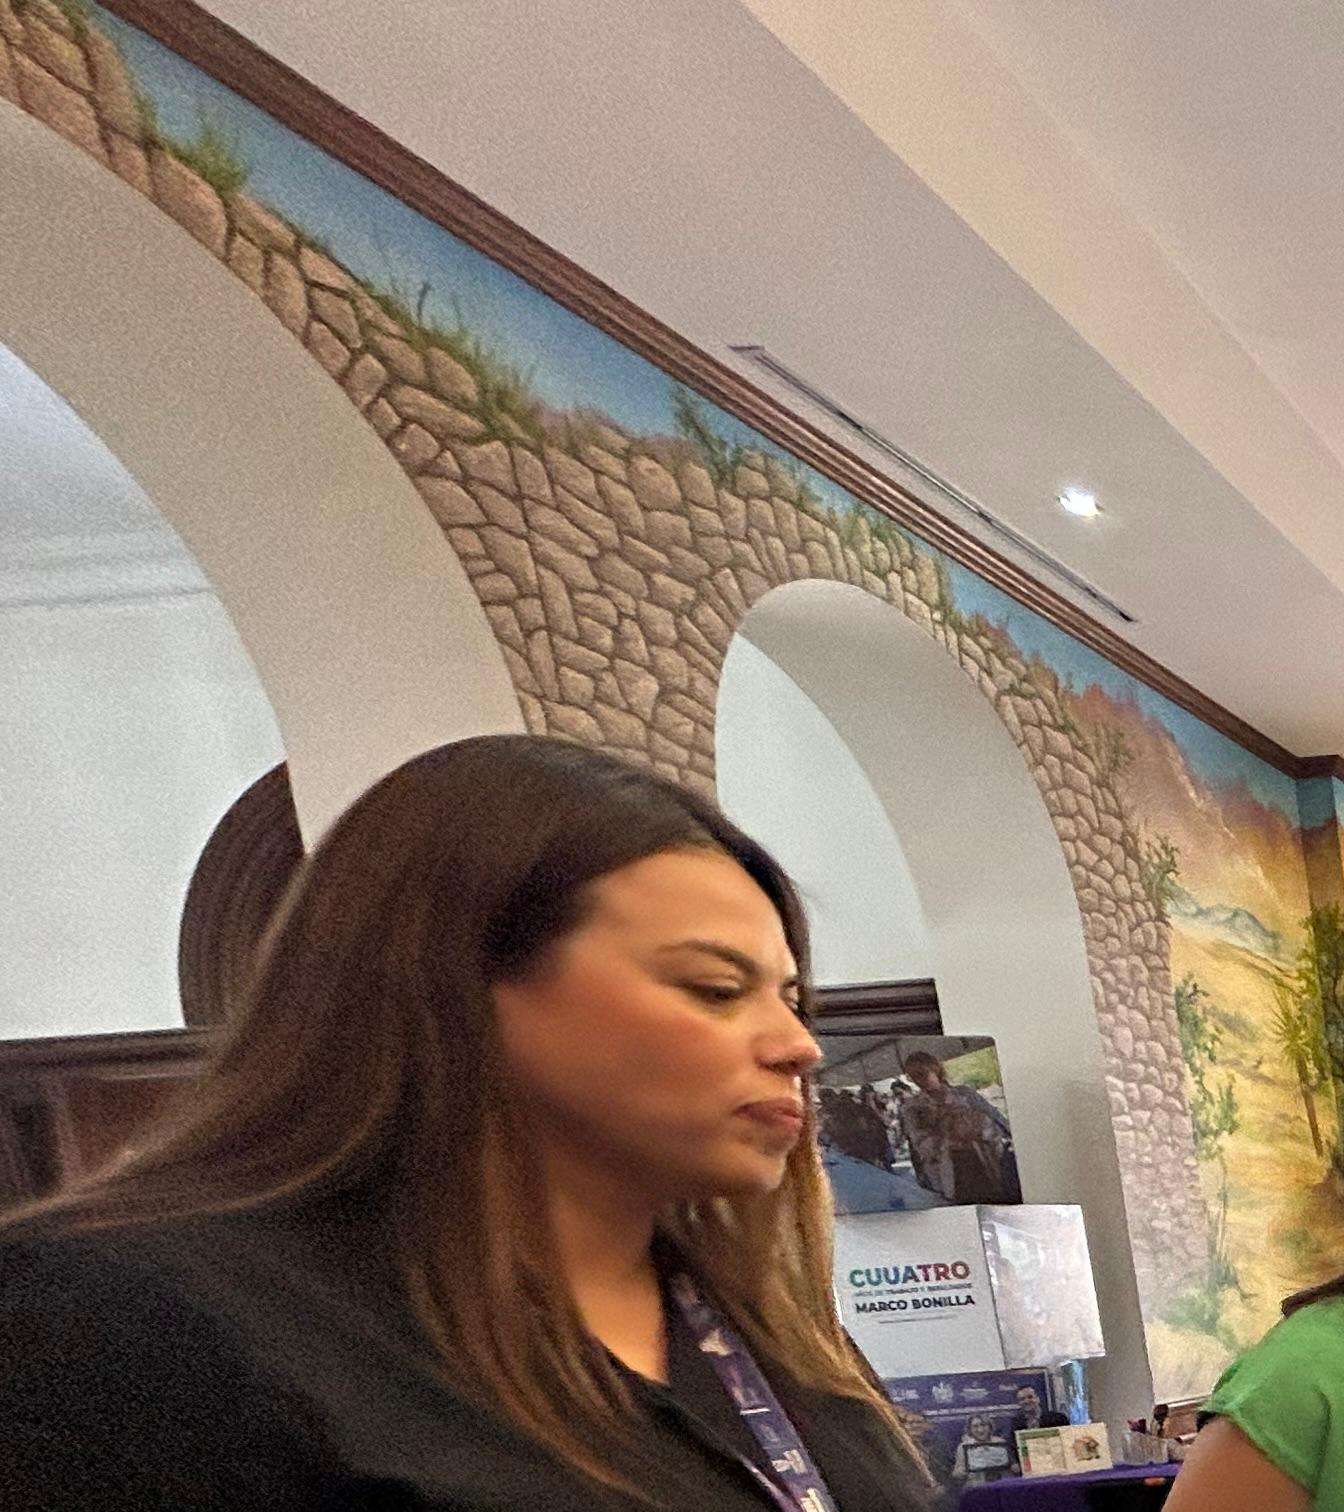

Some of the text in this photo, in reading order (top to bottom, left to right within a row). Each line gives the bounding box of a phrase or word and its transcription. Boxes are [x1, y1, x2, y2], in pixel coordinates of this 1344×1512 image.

[849, 1261, 971, 1287] CUUATRO
[855, 1295, 975, 1313] MARCO BONILLA
